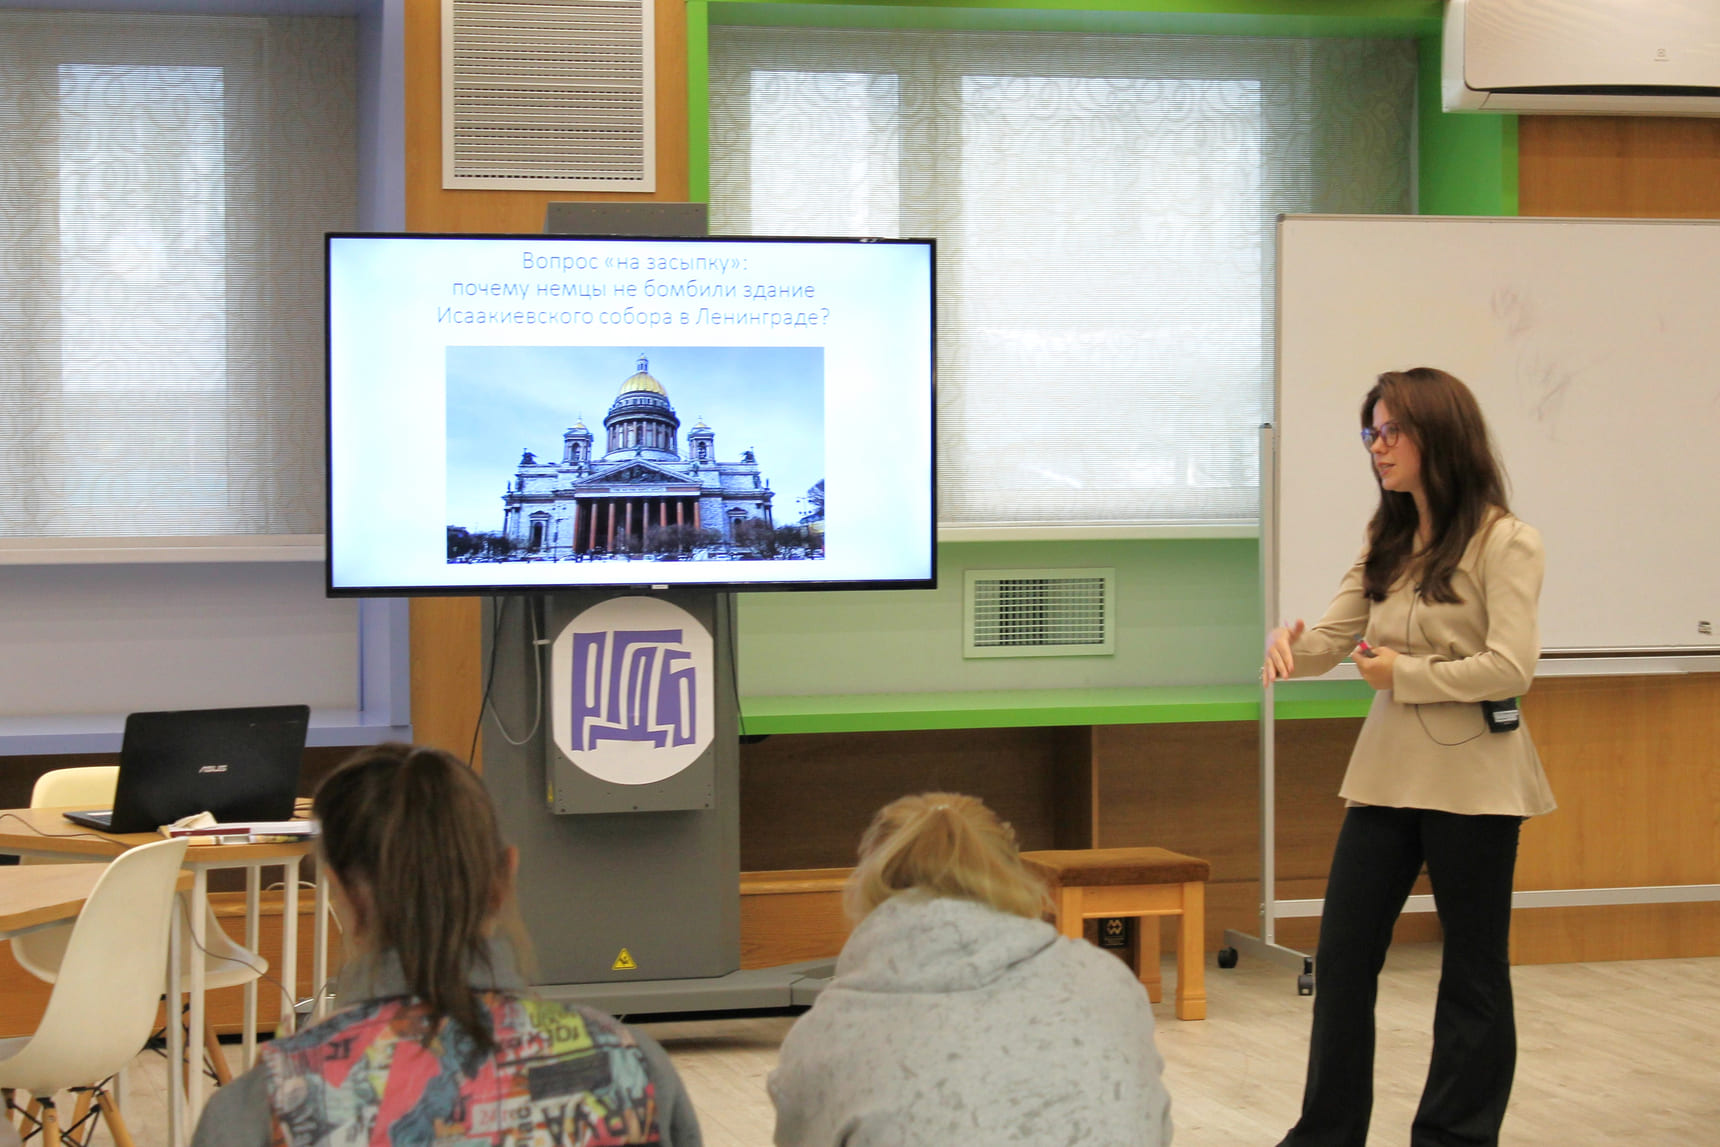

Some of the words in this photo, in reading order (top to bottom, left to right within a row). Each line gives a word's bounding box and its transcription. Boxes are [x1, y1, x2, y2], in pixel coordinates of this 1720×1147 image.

[523, 252, 599, 272] Вопрос
[605, 256, 640, 270] «на
[647, 257, 748, 275] засыпку»:
[453, 283, 530, 300] почему
[537, 283, 606, 300] немцы
[614, 284, 638, 297] не
[644, 279, 737, 298] бомбили
[743, 285, 816, 301] здание
[438, 306, 594, 325] Исаакиевского
[599, 306, 672, 328] собора
[680, 312, 689, 325] в
[696, 307, 830, 329] Ленинграде?
[198, 764, 229, 774] ASUS
